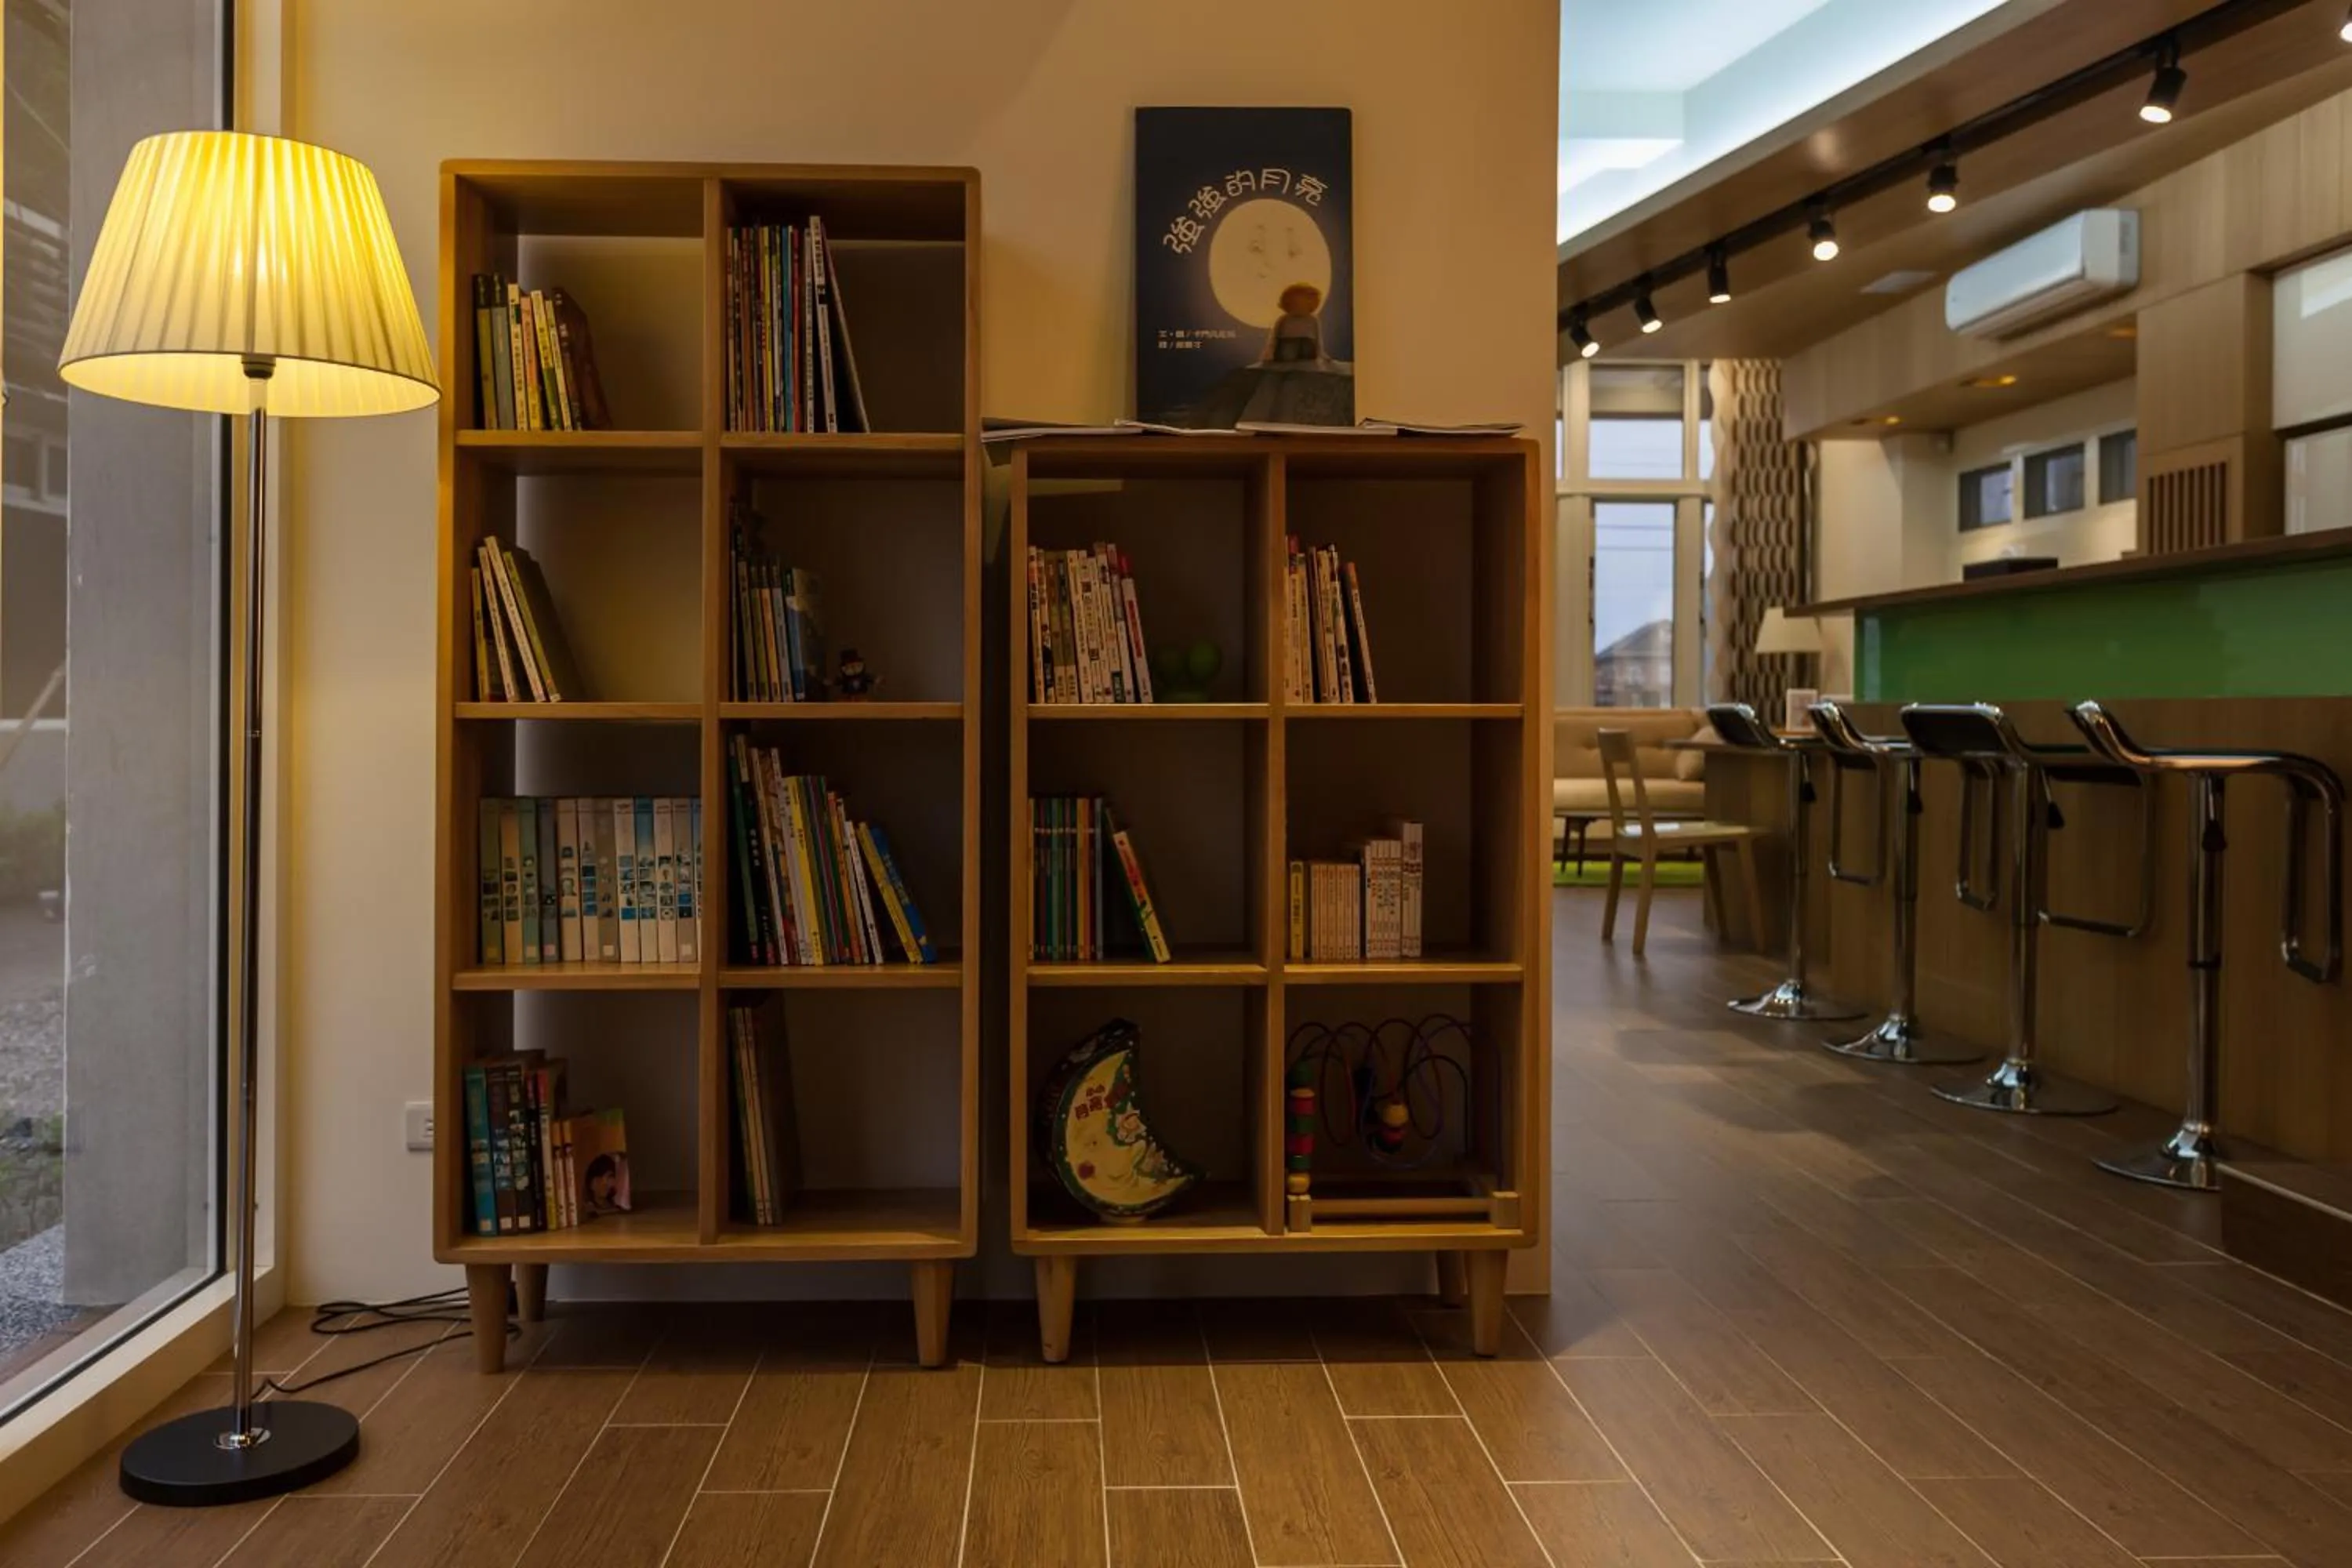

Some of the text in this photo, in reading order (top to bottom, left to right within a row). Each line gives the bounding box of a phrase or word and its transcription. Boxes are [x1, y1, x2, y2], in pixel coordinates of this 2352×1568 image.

[1163, 168, 1328, 255] 強強的月亮
